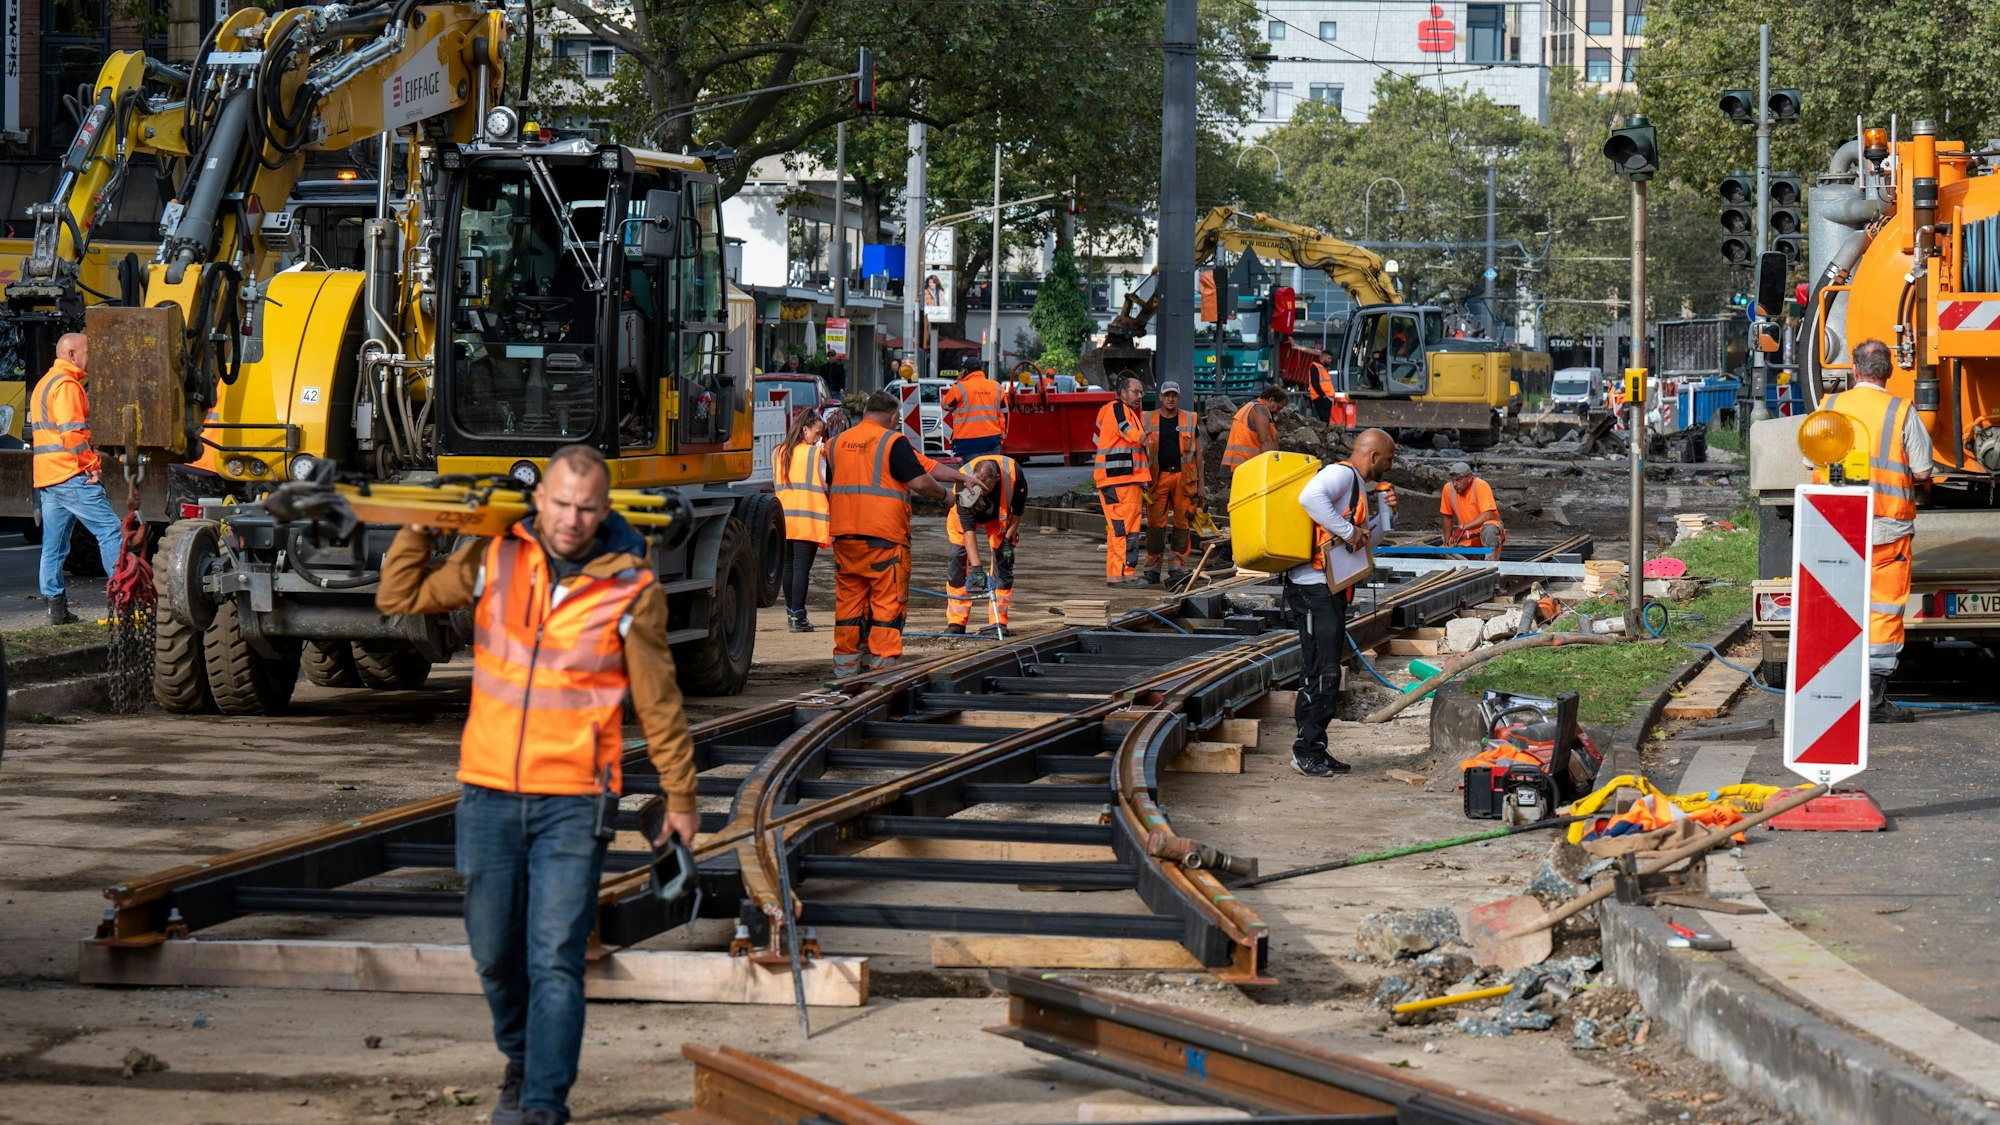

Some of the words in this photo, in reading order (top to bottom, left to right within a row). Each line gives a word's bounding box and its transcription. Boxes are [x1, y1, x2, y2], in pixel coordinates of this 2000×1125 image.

[405, 71, 439, 104] EIFFAGE
[303, 390, 317, 402] 42
[1957, 596, 1968, 612] K
